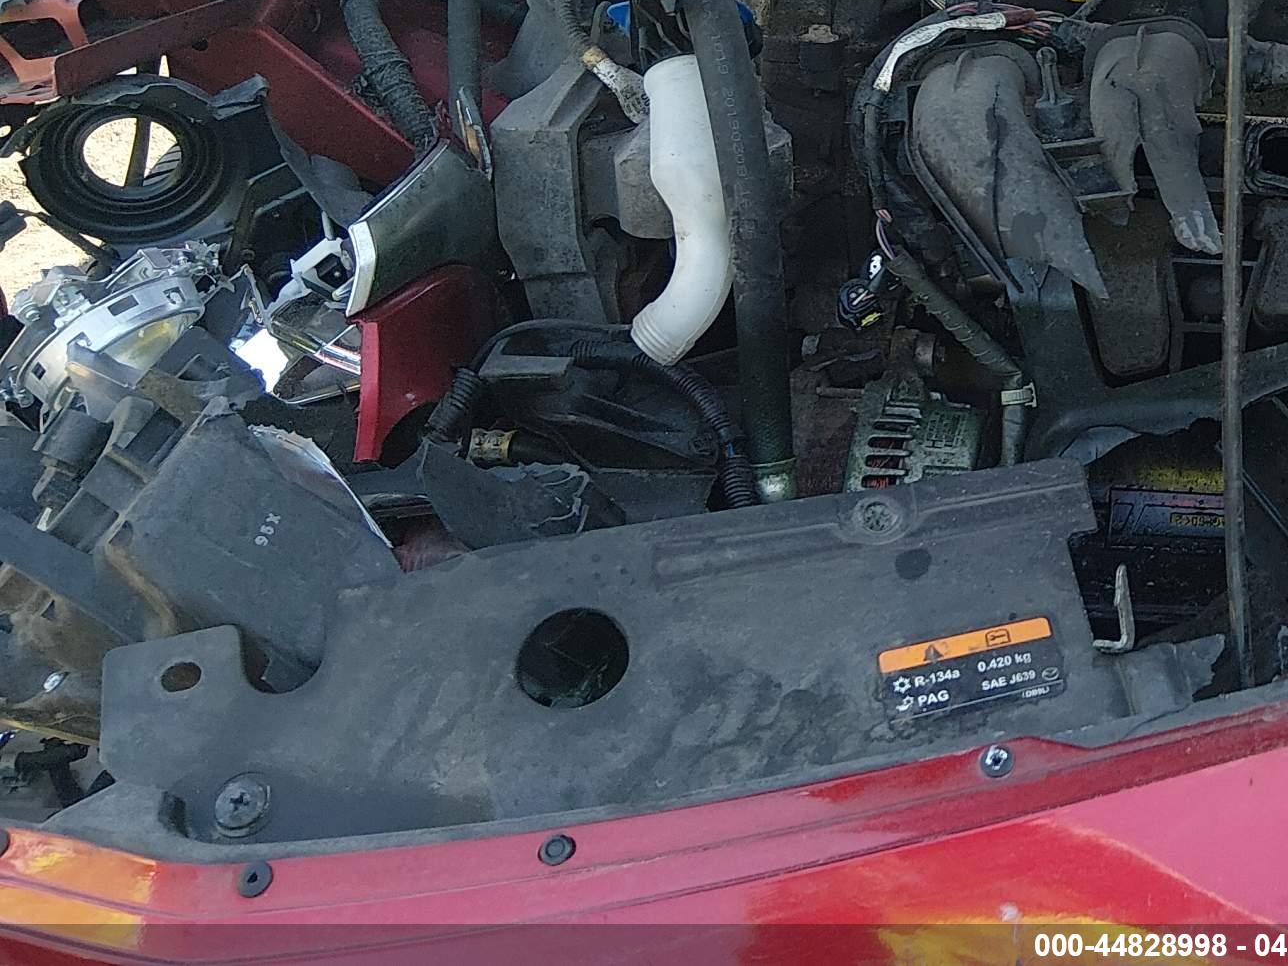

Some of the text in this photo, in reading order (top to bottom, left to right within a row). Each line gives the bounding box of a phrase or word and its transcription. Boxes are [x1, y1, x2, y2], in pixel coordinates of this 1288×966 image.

[914, 652, 1032, 688] R-134a 0.420 kg
[917, 670, 1036, 708] PAG SAE J639
